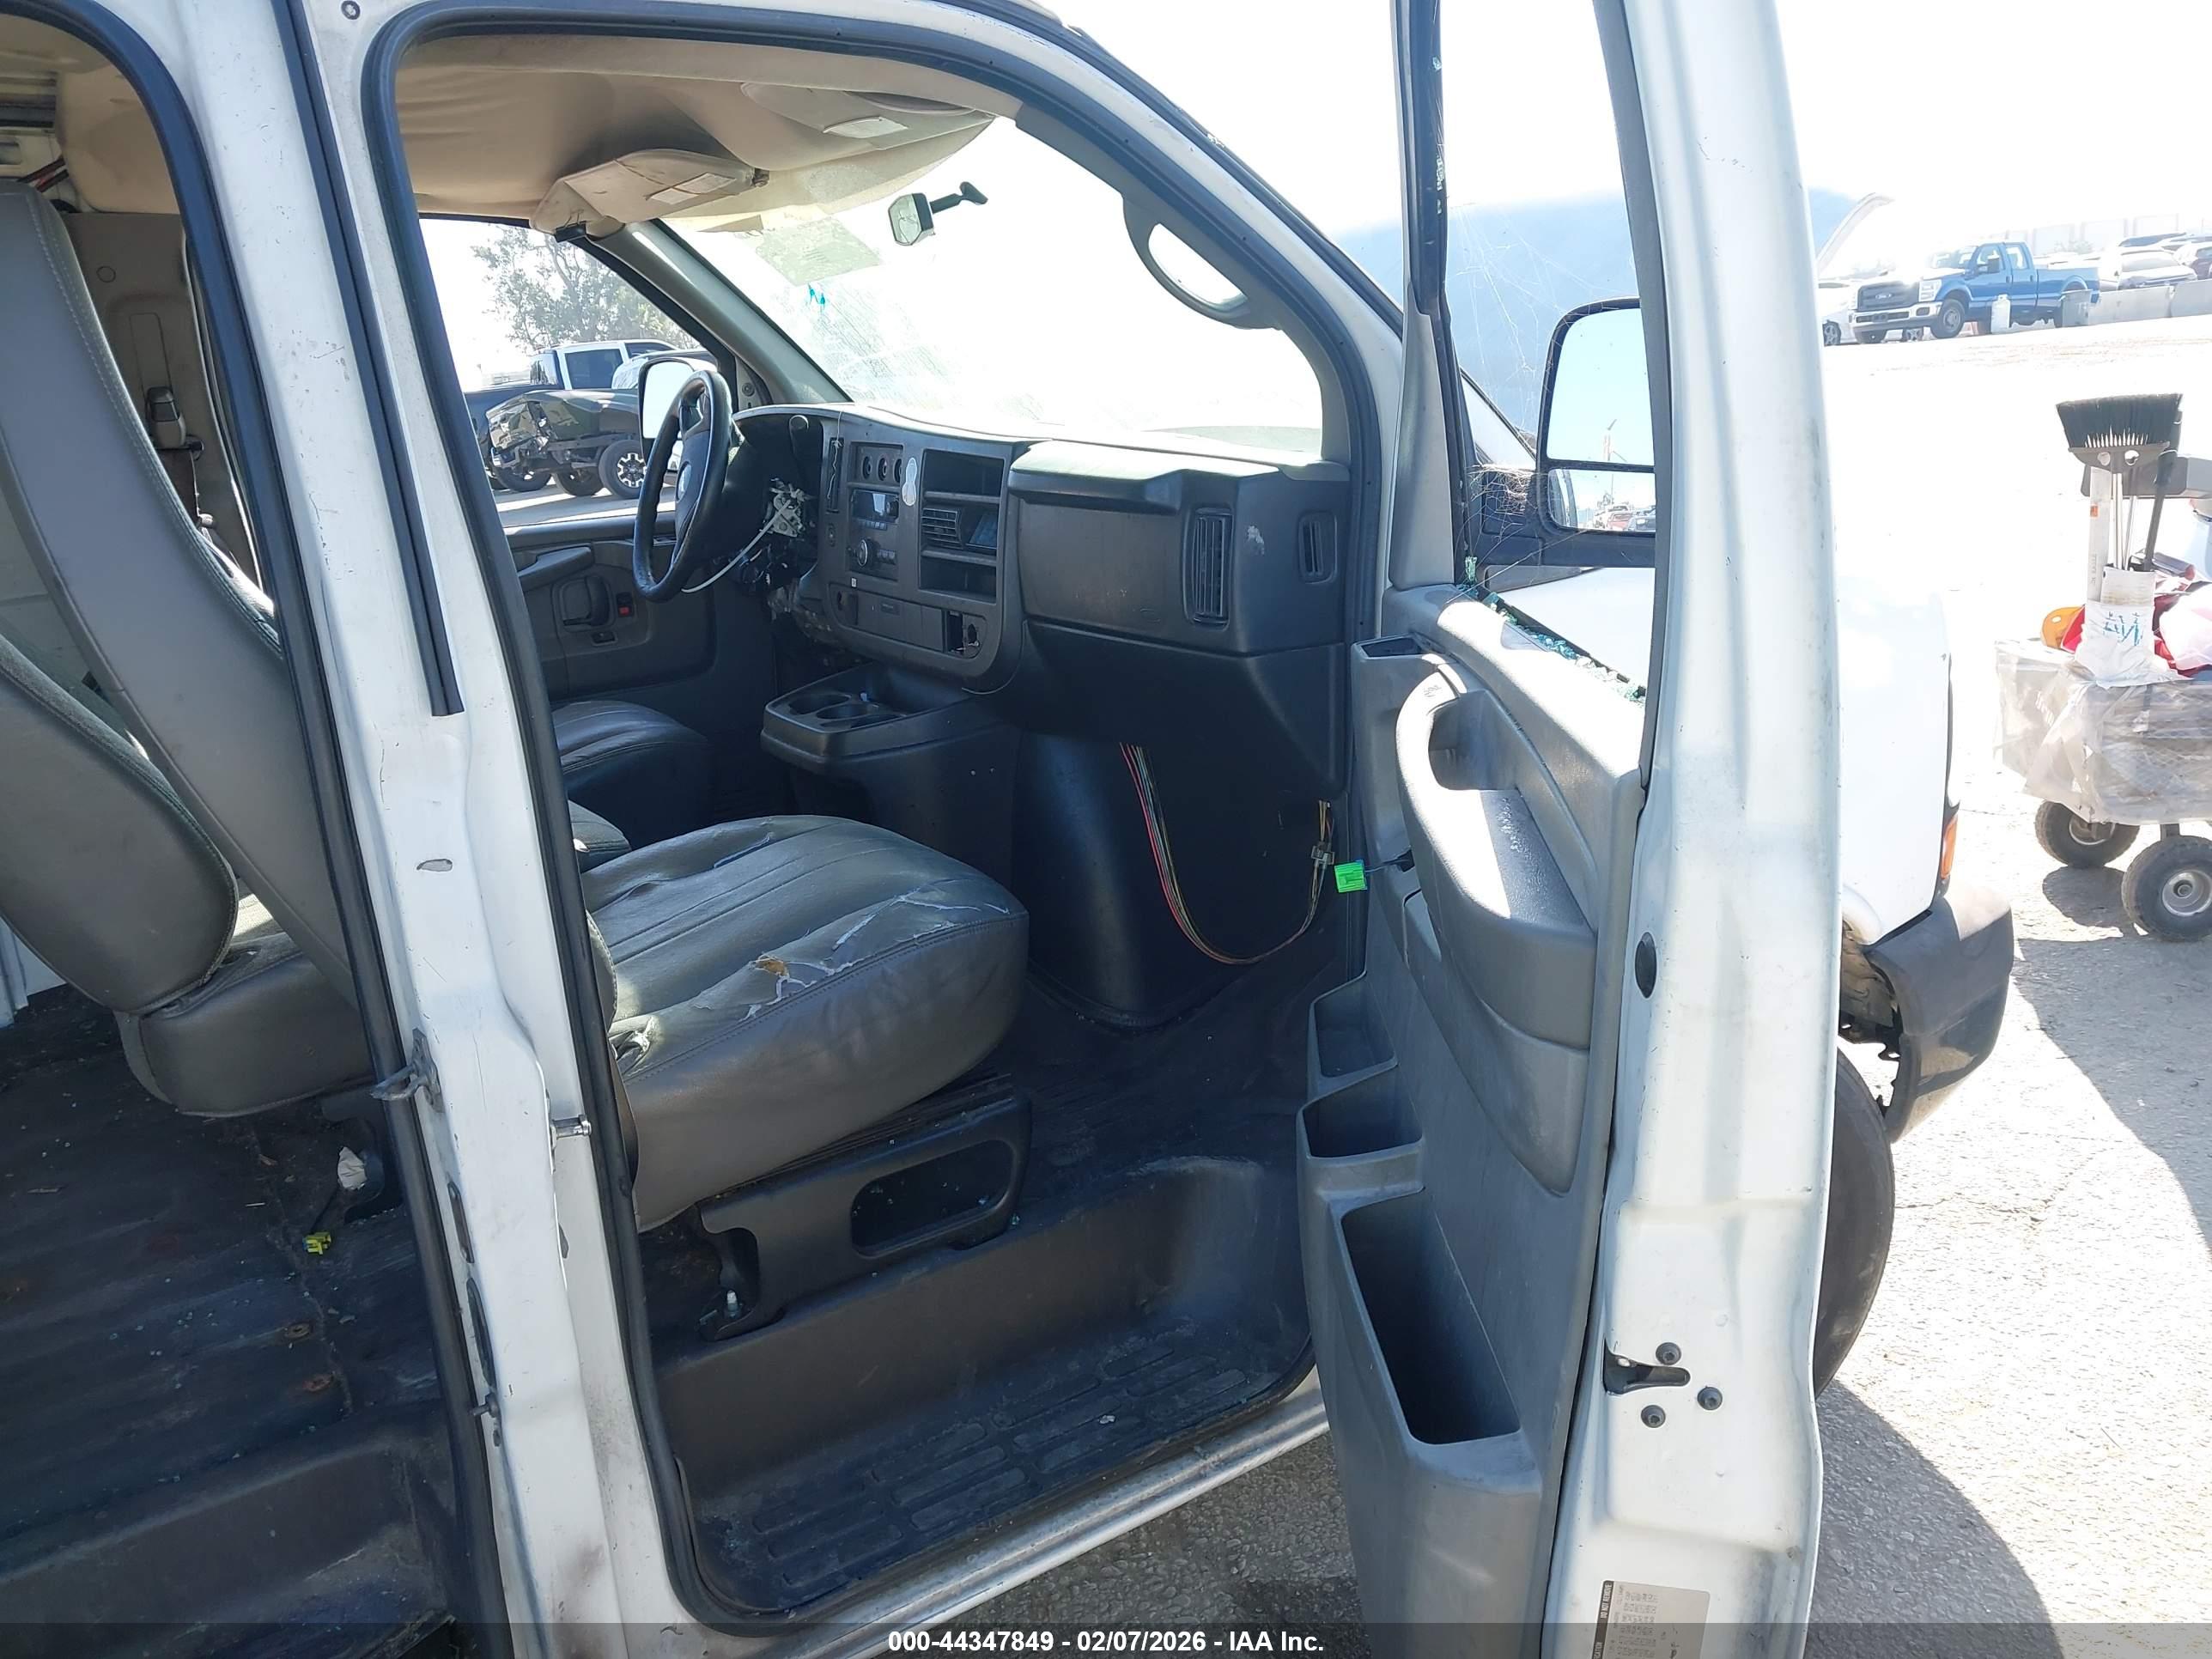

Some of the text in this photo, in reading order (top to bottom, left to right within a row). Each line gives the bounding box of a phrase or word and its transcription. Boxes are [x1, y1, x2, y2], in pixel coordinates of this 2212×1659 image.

[1600, 1583, 1612, 1620] DO NOT REMOVE
